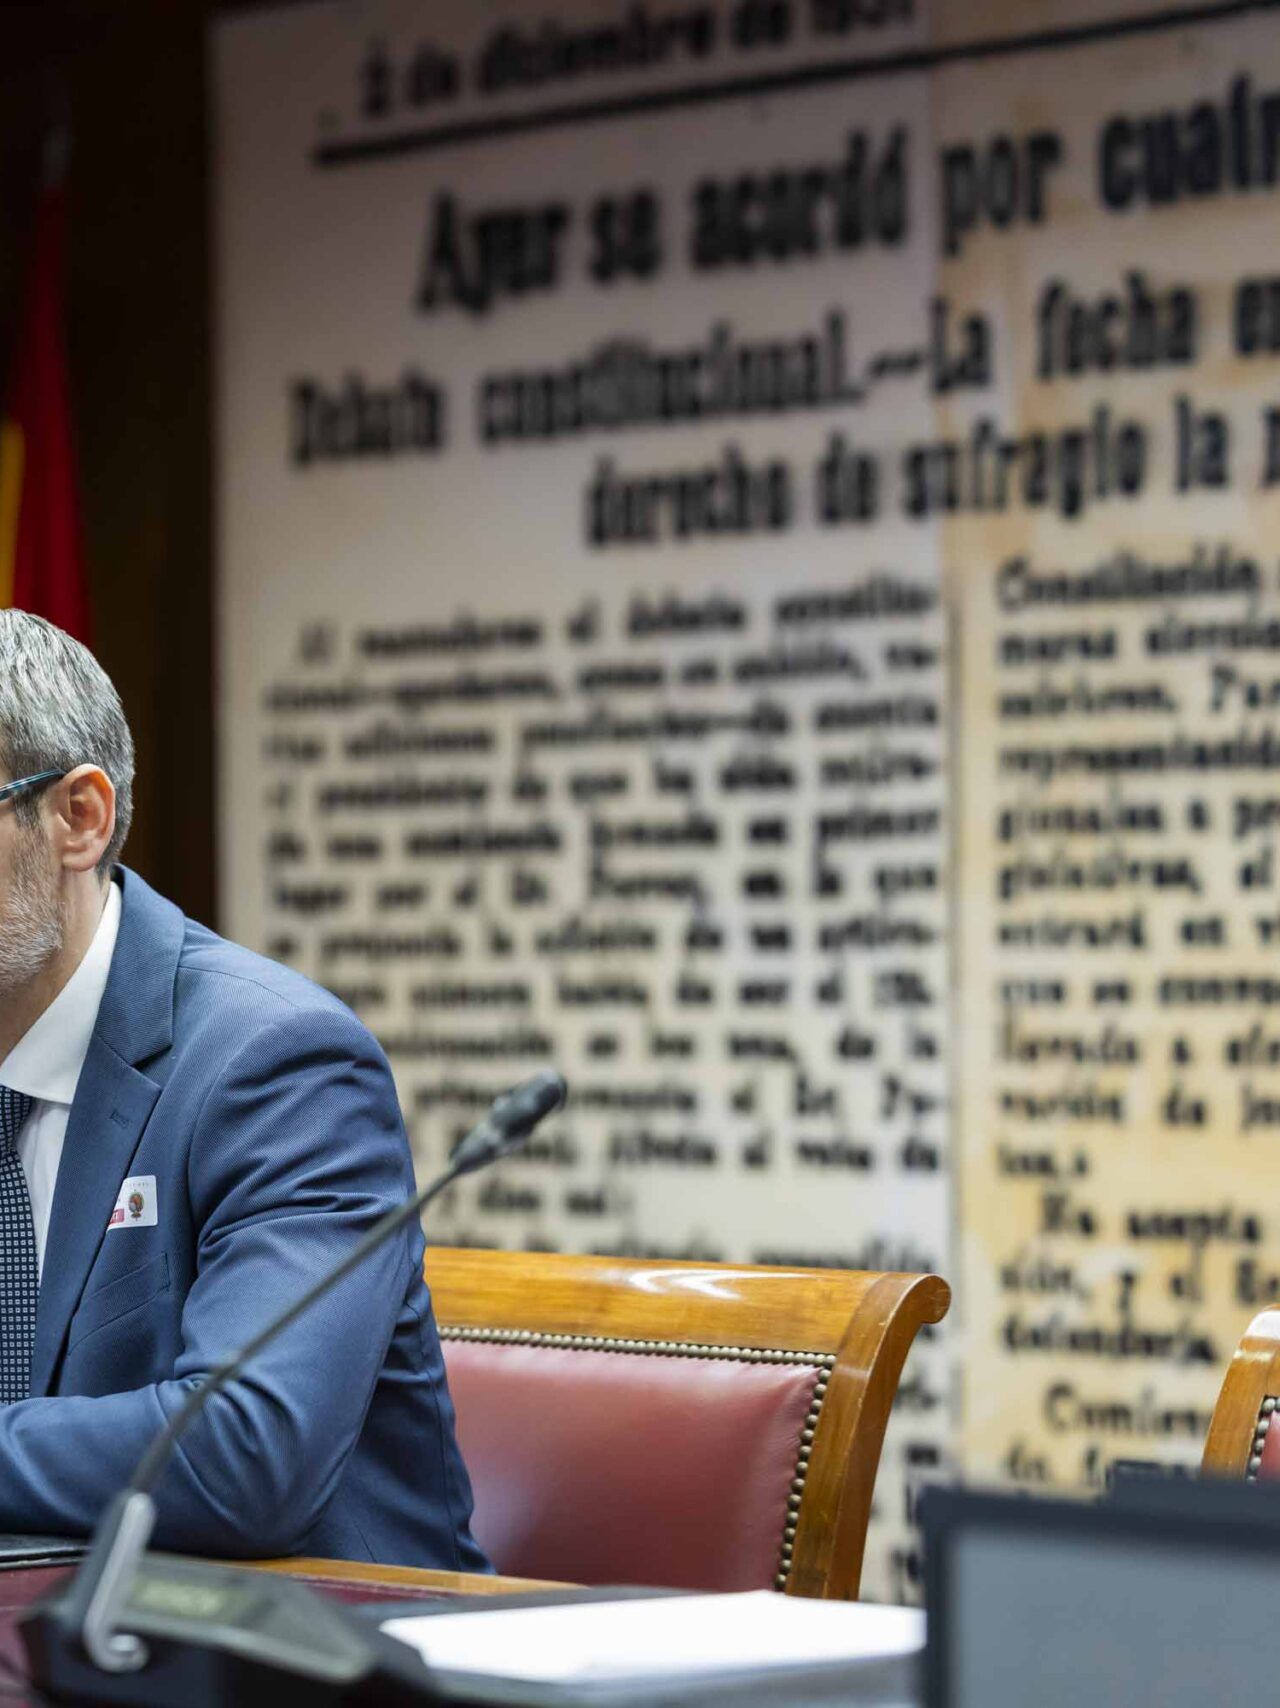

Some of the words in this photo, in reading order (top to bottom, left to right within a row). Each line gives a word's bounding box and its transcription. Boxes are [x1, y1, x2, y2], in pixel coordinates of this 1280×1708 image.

[586, 187, 661, 287] se
[939, 127, 1065, 261] por
[1036, 269, 1198, 383] fecha
[815, 432, 881, 528] de
[1174, 393, 1232, 495] la
